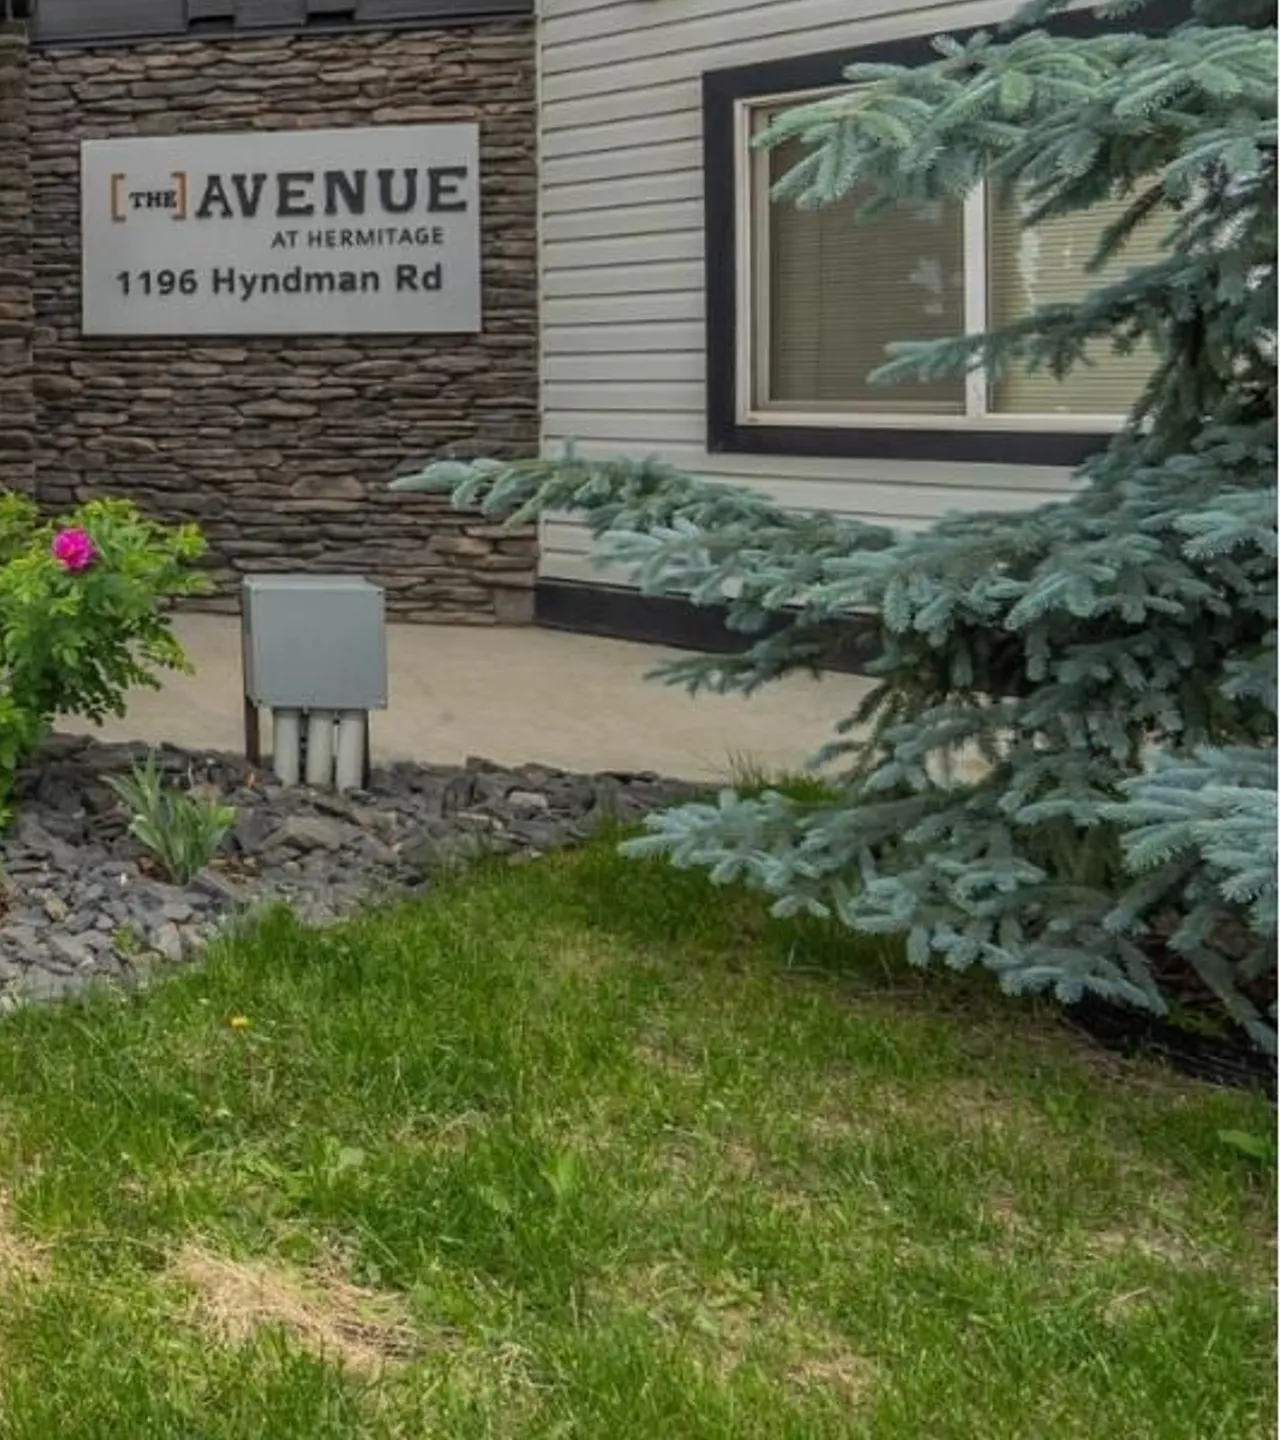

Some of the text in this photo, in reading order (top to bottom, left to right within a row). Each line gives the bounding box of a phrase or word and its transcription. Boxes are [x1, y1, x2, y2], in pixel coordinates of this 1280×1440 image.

[195, 166, 468, 218] AVENUE
[271, 227, 444, 248] AT HERMITAGE
[117, 263, 443, 301] 1196 Hyndman Rd
